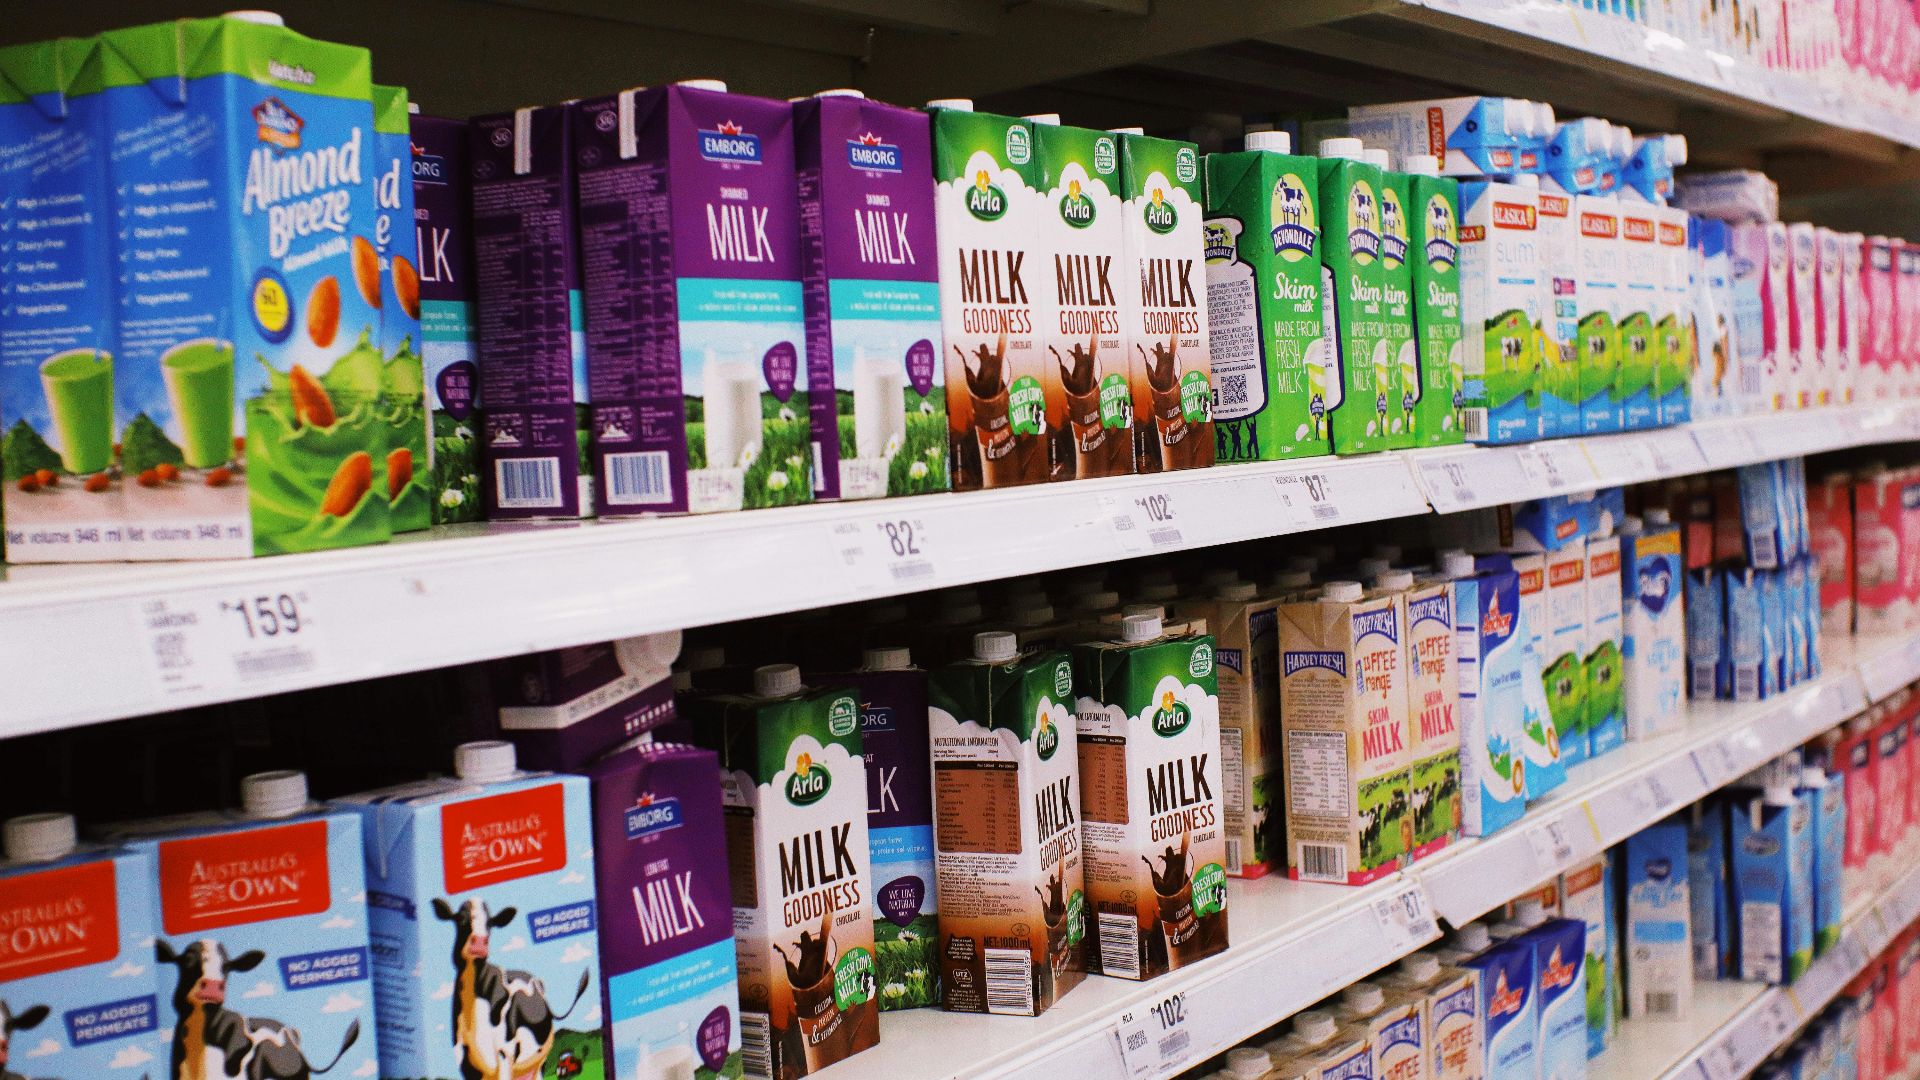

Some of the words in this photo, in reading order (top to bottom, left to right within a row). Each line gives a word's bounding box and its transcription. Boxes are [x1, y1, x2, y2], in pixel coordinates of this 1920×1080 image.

[704, 137, 755, 157] EMBORG
[852, 147, 896, 166] EMBORG
[243, 126, 362, 215] Almond
[970, 189, 1001, 212] Arla
[1064, 197, 1090, 219] Arla
[268, 189, 351, 259] Breeze
[1148, 206, 1172, 226] Arla
[1494, 206, 1526, 226] ALASKA
[706, 203, 775, 263] MILK
[854, 209, 916, 265] MILK
[1273, 229, 1313, 252] DEVONDALE
[1350, 235, 1378, 254] DEVONDALE
[416, 225, 454, 282] LK
[1205, 247, 1232, 259] VONDALE
[958, 247, 1029, 305] MILK
[1055, 253, 1117, 306] MILK
[1139, 258, 1197, 308] MILK
[1273, 271, 1318, 301] Skim
[1350, 274, 1382, 301] Skim
[1384, 281, 1409, 305] kim
[1427, 281, 1458, 306] Skim
[1294, 301, 1314, 313] milk
[1365, 302, 1379, 314] milk
[963, 308, 1033, 334] GOODNESS
[1059, 310, 1120, 334] GOODNESS
[1143, 311, 1200, 334] GOODNESS
[1274, 321, 1297, 337] MADE
[1298, 321, 1320, 336] FROM
[1351, 322, 1367, 336] MADE
[1367, 322, 1384, 336] FROM
[1276, 340, 1300, 369] FRESH
[1351, 340, 1370, 368] FRESH
[1429, 340, 1448, 367] FRESH
[1220, 363, 1256, 373] conversation
[1430, 370, 1448, 389] MILK
[1277, 370, 1304, 394] MILK
[1353, 370, 1372, 392] MILK
[1012, 404, 1031, 427] MILK
[1103, 400, 1120, 423] MILK
[1183, 396, 1199, 416] MILK
[1408, 602, 1429, 627] HARVEY
[1429, 598, 1449, 623] FRESH
[1353, 616, 1375, 642] HARVEY
[1375, 612, 1396, 638] FRESH
[1216, 651, 1241, 670] FRESH
[1286, 654, 1319, 673] HARVEY
[1319, 654, 1344, 673] FRESH
[1420, 658, 1446, 683] range
[1365, 674, 1392, 699] range
[1424, 690, 1443, 706] SKIM
[1157, 708, 1185, 731] Arla
[1368, 707, 1390, 724] SKIM
[1420, 704, 1455, 742] MILK
[967, 737, 999, 747] INFORMATION
[1039, 732, 1055, 754] Arla
[1362, 728, 1404, 762] MILK
[792, 772, 824, 799] Arla
[1146, 753, 1213, 817] MILK
[628, 805, 674, 832] EMBORG
[1035, 775, 1075, 845] MILK
[461, 811, 541, 843] AUSTRALIA'S
[1150, 803, 1216, 843] GOODNESS
[488, 837, 544, 863] OWN
[778, 821, 857, 898] MILK
[1039, 827, 1078, 871] GOODNESS
[190, 852, 297, 884] AUSTRALIA'S
[228, 874, 299, 902] OWN
[888, 889, 900, 900] WE
[901, 887, 916, 899] LOVE
[1192, 875, 1212, 896] FRESH
[0, 896, 86, 928] STRALIA'S
[632, 870, 706, 947] MILK
[783, 879, 861, 928] GOODNESS
[888, 898, 916, 911] NATURAL
[1194, 891, 1214, 910] MILK
[533, 915, 550, 927] NO
[553, 906, 590, 924] ADDED
[535, 917, 592, 940] PERMEATE
[835, 910, 861, 927] CHOCOLATE
[10, 923, 86, 954] OWN
[1172, 927, 1181, 946] &
[287, 959, 309, 973] NO
[313, 952, 362, 968] ADDED
[835, 962, 855, 987] FRESH
[855, 954, 873, 973] COW'S
[955, 970, 969, 978] UTZ
[289, 966, 361, 987] PERMEATE
[838, 979, 859, 1003] MILK
[73, 1012, 96, 1027] NO
[101, 1001, 148, 1020] ADDED
[75, 1015, 149, 1041] PERMEATE
[811, 1024, 820, 1045] &
